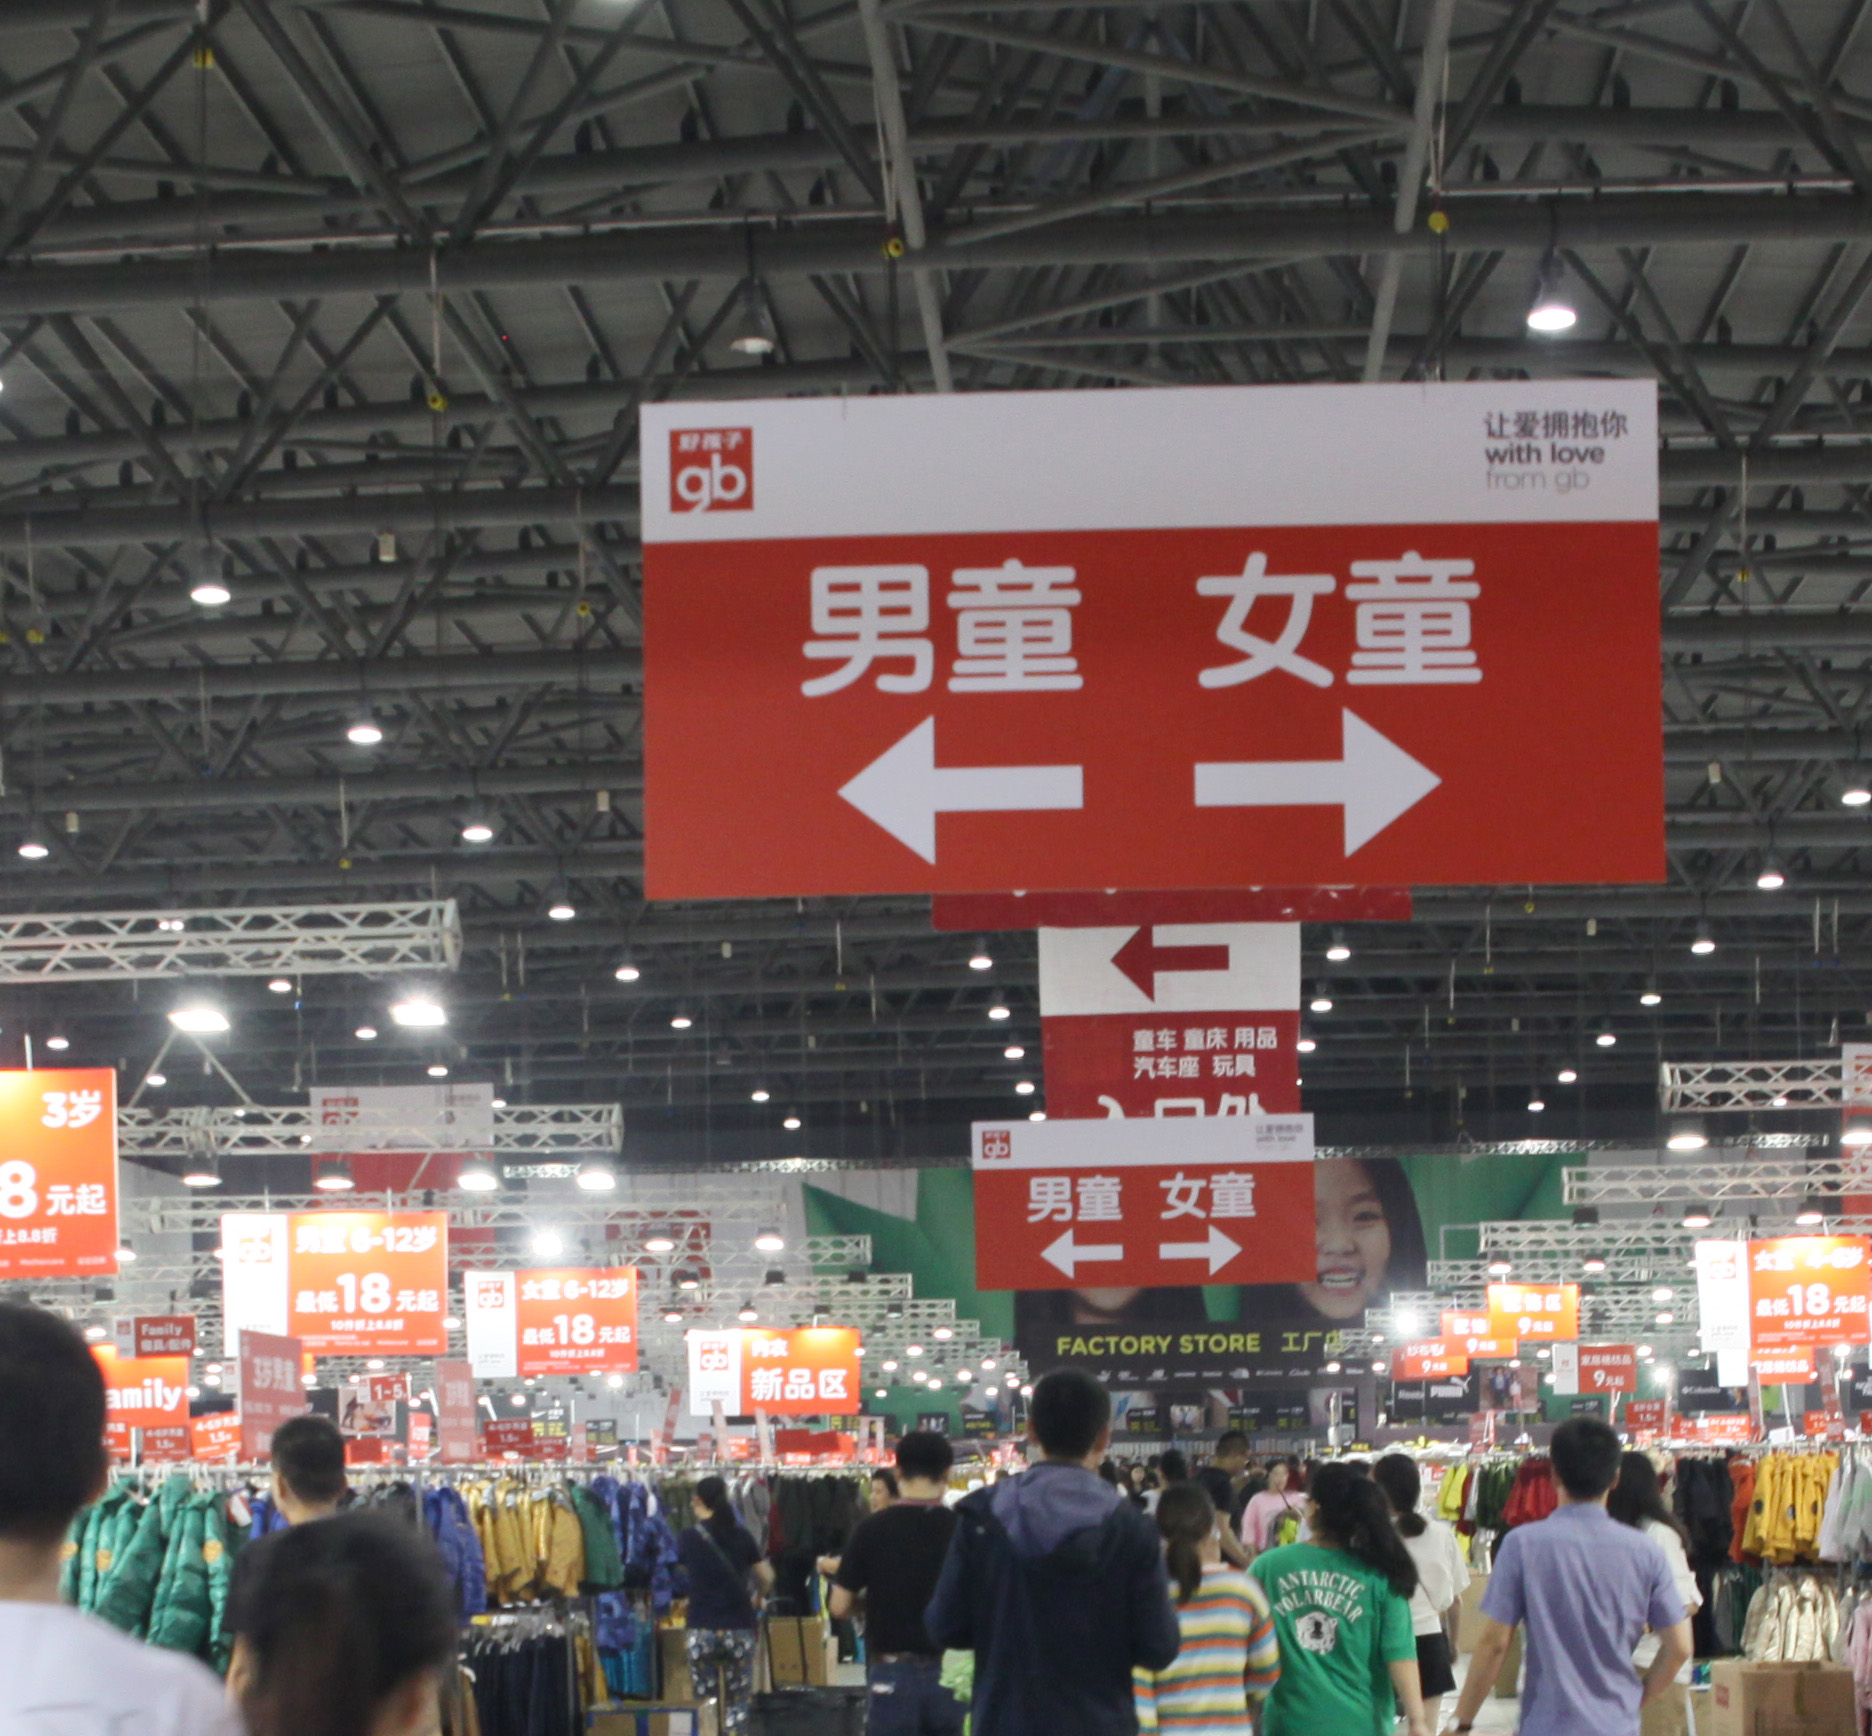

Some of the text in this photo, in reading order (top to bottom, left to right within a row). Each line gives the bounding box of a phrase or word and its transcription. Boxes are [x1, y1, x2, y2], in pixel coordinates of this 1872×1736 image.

[679, 431, 743, 452] 好孩子
[1485, 411, 1629, 440] 让爱拥抱你
[1486, 440, 1606, 465] with love
[676, 451, 747, 513] gb
[1486, 467, 1548, 490] from
[800, 551, 1483, 698] 男童 女童
[1133, 1026, 1278, 1052] 童车 童床 用品
[1133, 1054, 1256, 1079] 汽车座 玩具
[40, 1089, 103, 1129] 3岁
[1027, 1171, 1256, 1223] 男童 女童
[295, 1272, 440, 1313] 最低18元起
[1756, 1283, 1867, 1317] 最低18元起
[522, 1313, 632, 1346] 最低18元起
[1057, 1335, 1172, 1356] FACTORY
[1179, 1333, 1261, 1354] STORE
[105, 1377, 182, 1411] amily
[750, 1367, 848, 1402] 新品区
[1279, 1570, 1365, 1600] ANTARCTIC
[1274, 1588, 1363, 1623] POLARBEAR
